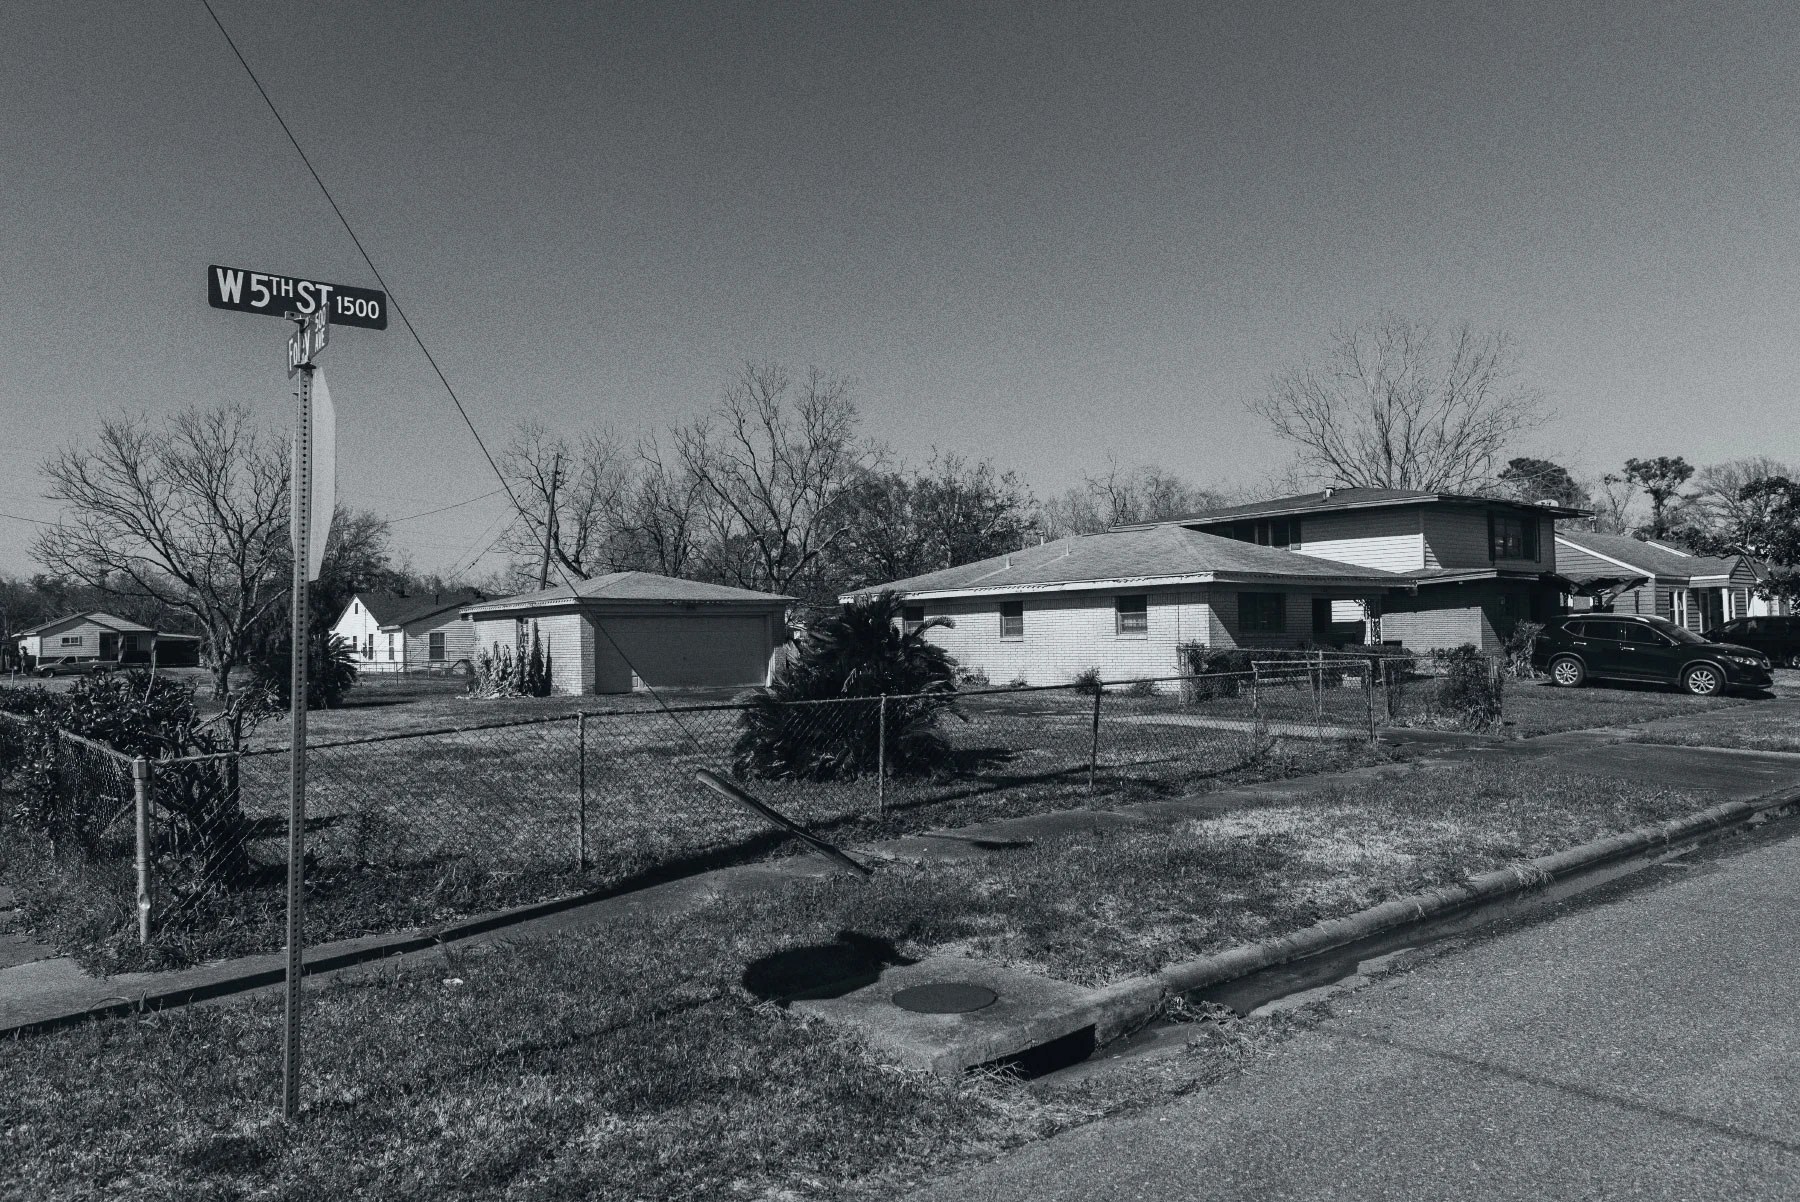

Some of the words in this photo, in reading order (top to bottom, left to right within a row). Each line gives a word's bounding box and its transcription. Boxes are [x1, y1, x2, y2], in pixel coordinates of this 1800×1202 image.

[216, 268, 244, 304] W
[250, 273, 294, 308] 5TH
[296, 280, 334, 314] ST
[336, 295, 380, 319] 1500
